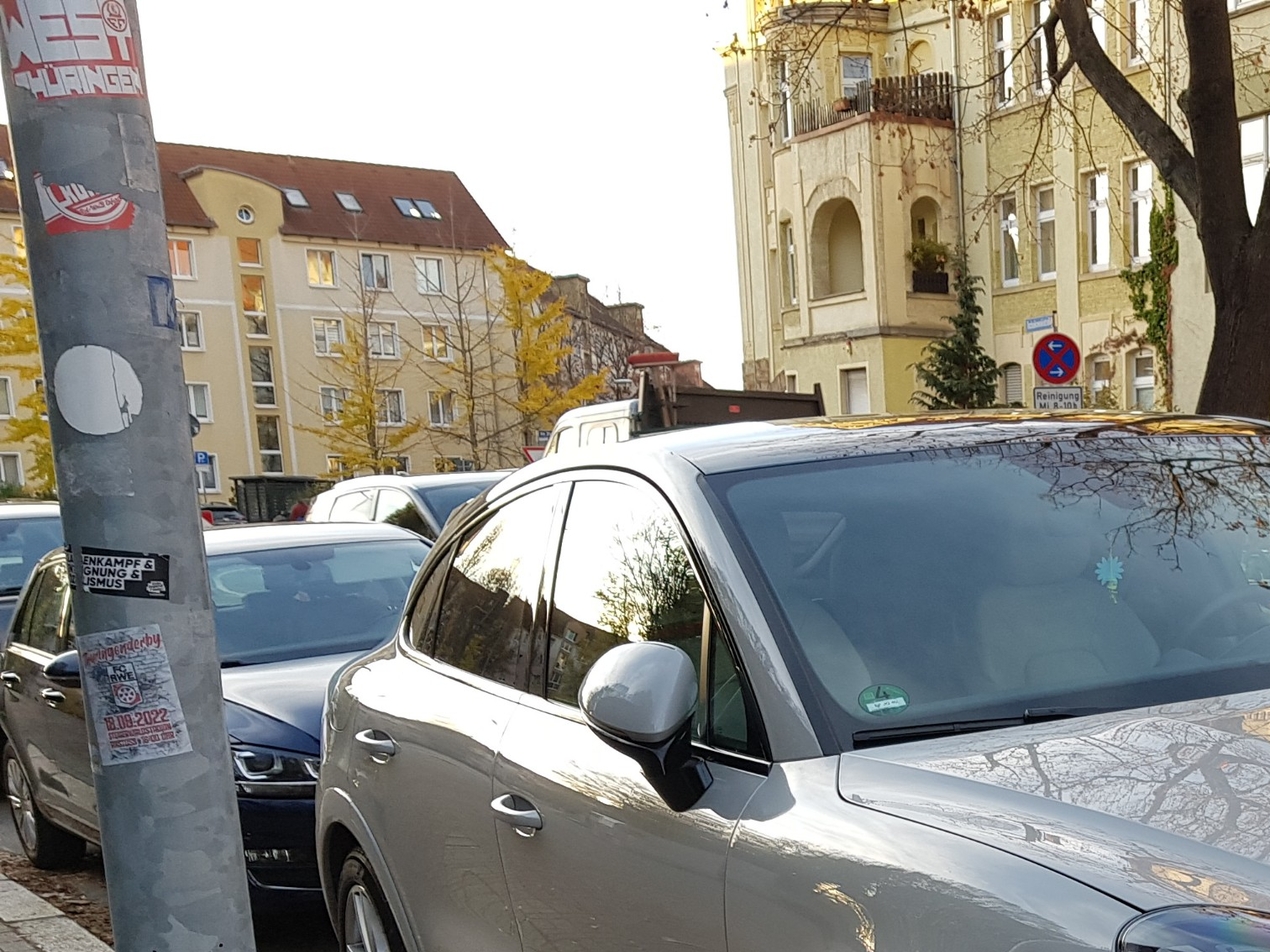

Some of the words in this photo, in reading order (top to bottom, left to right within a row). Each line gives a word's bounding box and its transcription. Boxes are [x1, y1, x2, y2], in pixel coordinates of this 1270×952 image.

[1036, 391, 1080, 402] Reinigung
[144, 559, 153, 570] &
[83, 566, 127, 578] GNUNG
[130, 569, 140, 579] &
[112, 663, 128, 673] FC
[110, 671, 136, 682] RWE
[875, 686, 890, 699] 4
